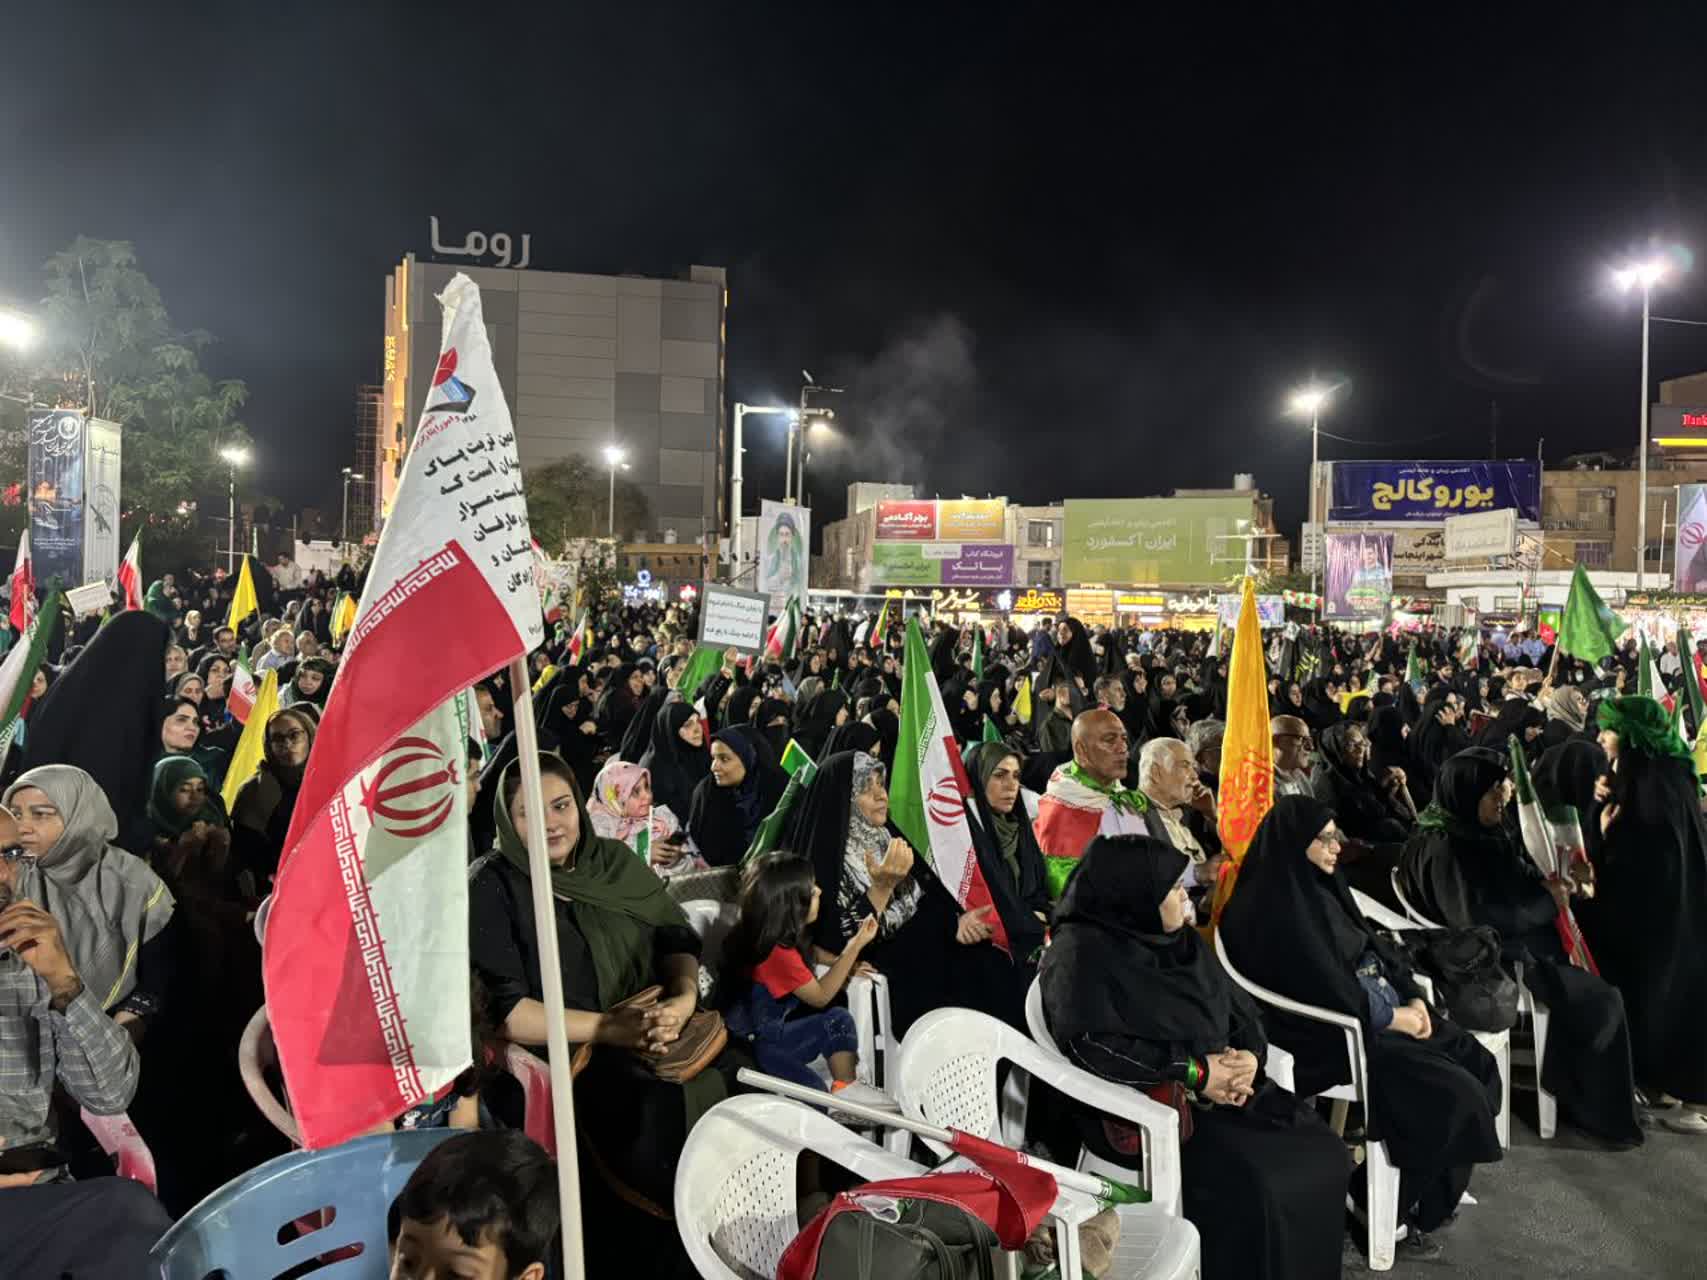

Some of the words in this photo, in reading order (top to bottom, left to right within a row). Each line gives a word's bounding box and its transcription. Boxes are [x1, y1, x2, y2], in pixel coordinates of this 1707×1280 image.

[430, 215, 531, 268] روما
[466, 433, 496, 455] تربت
[424, 448, 469, 477] پاک
[466, 460, 497, 482] است
[440, 473, 464, 495] که
[1371, 477, 1494, 511] یوروکالج
[458, 495, 495, 522] مزار
[1087, 531, 1144, 552] آکسفورد
[1144, 532, 1176, 553] ایران
